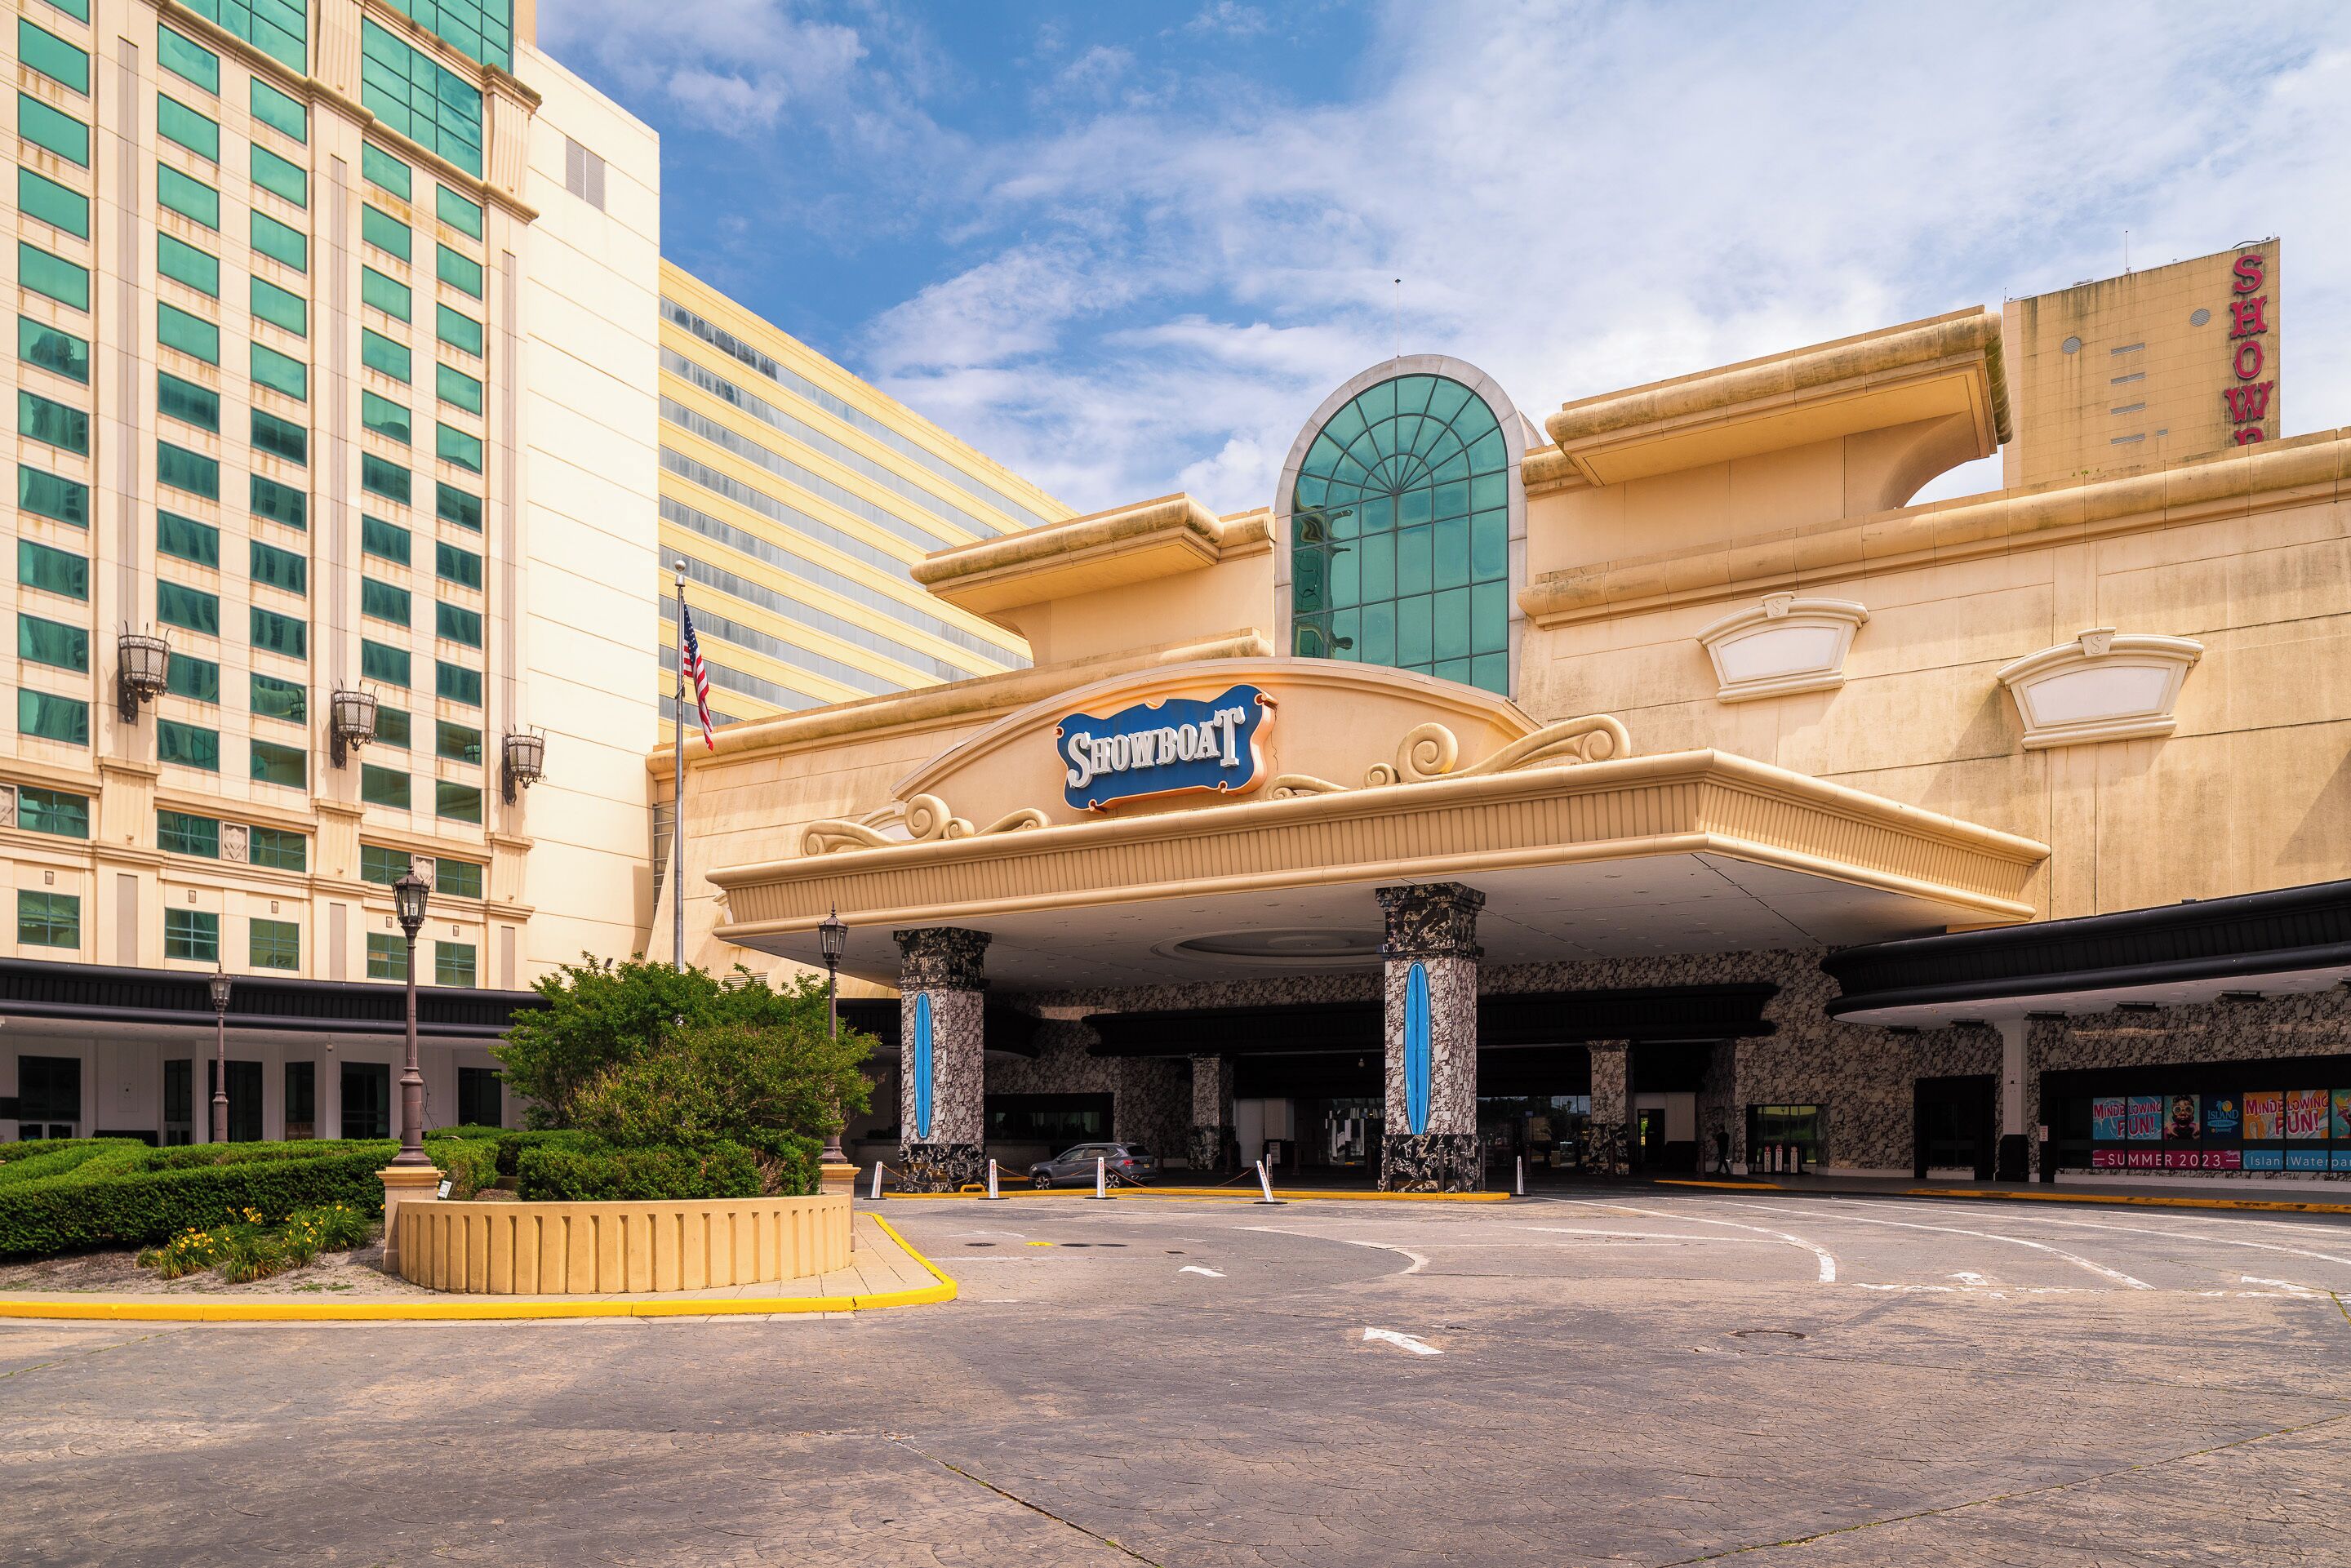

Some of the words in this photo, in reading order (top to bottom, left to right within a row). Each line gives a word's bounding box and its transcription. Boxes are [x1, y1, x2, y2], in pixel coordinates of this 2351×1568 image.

[2090, 635, 2103, 654] S
[1067, 705, 1246, 788] SHOWBOAT
[2207, 1110, 2239, 1120] ISLAND
[2275, 1112, 2318, 1135] FUN!
[2118, 1116, 2154, 1136] FUN!
[2108, 1153, 2172, 1166] SUMMER
[2180, 1154, 2220, 1166] 2023
